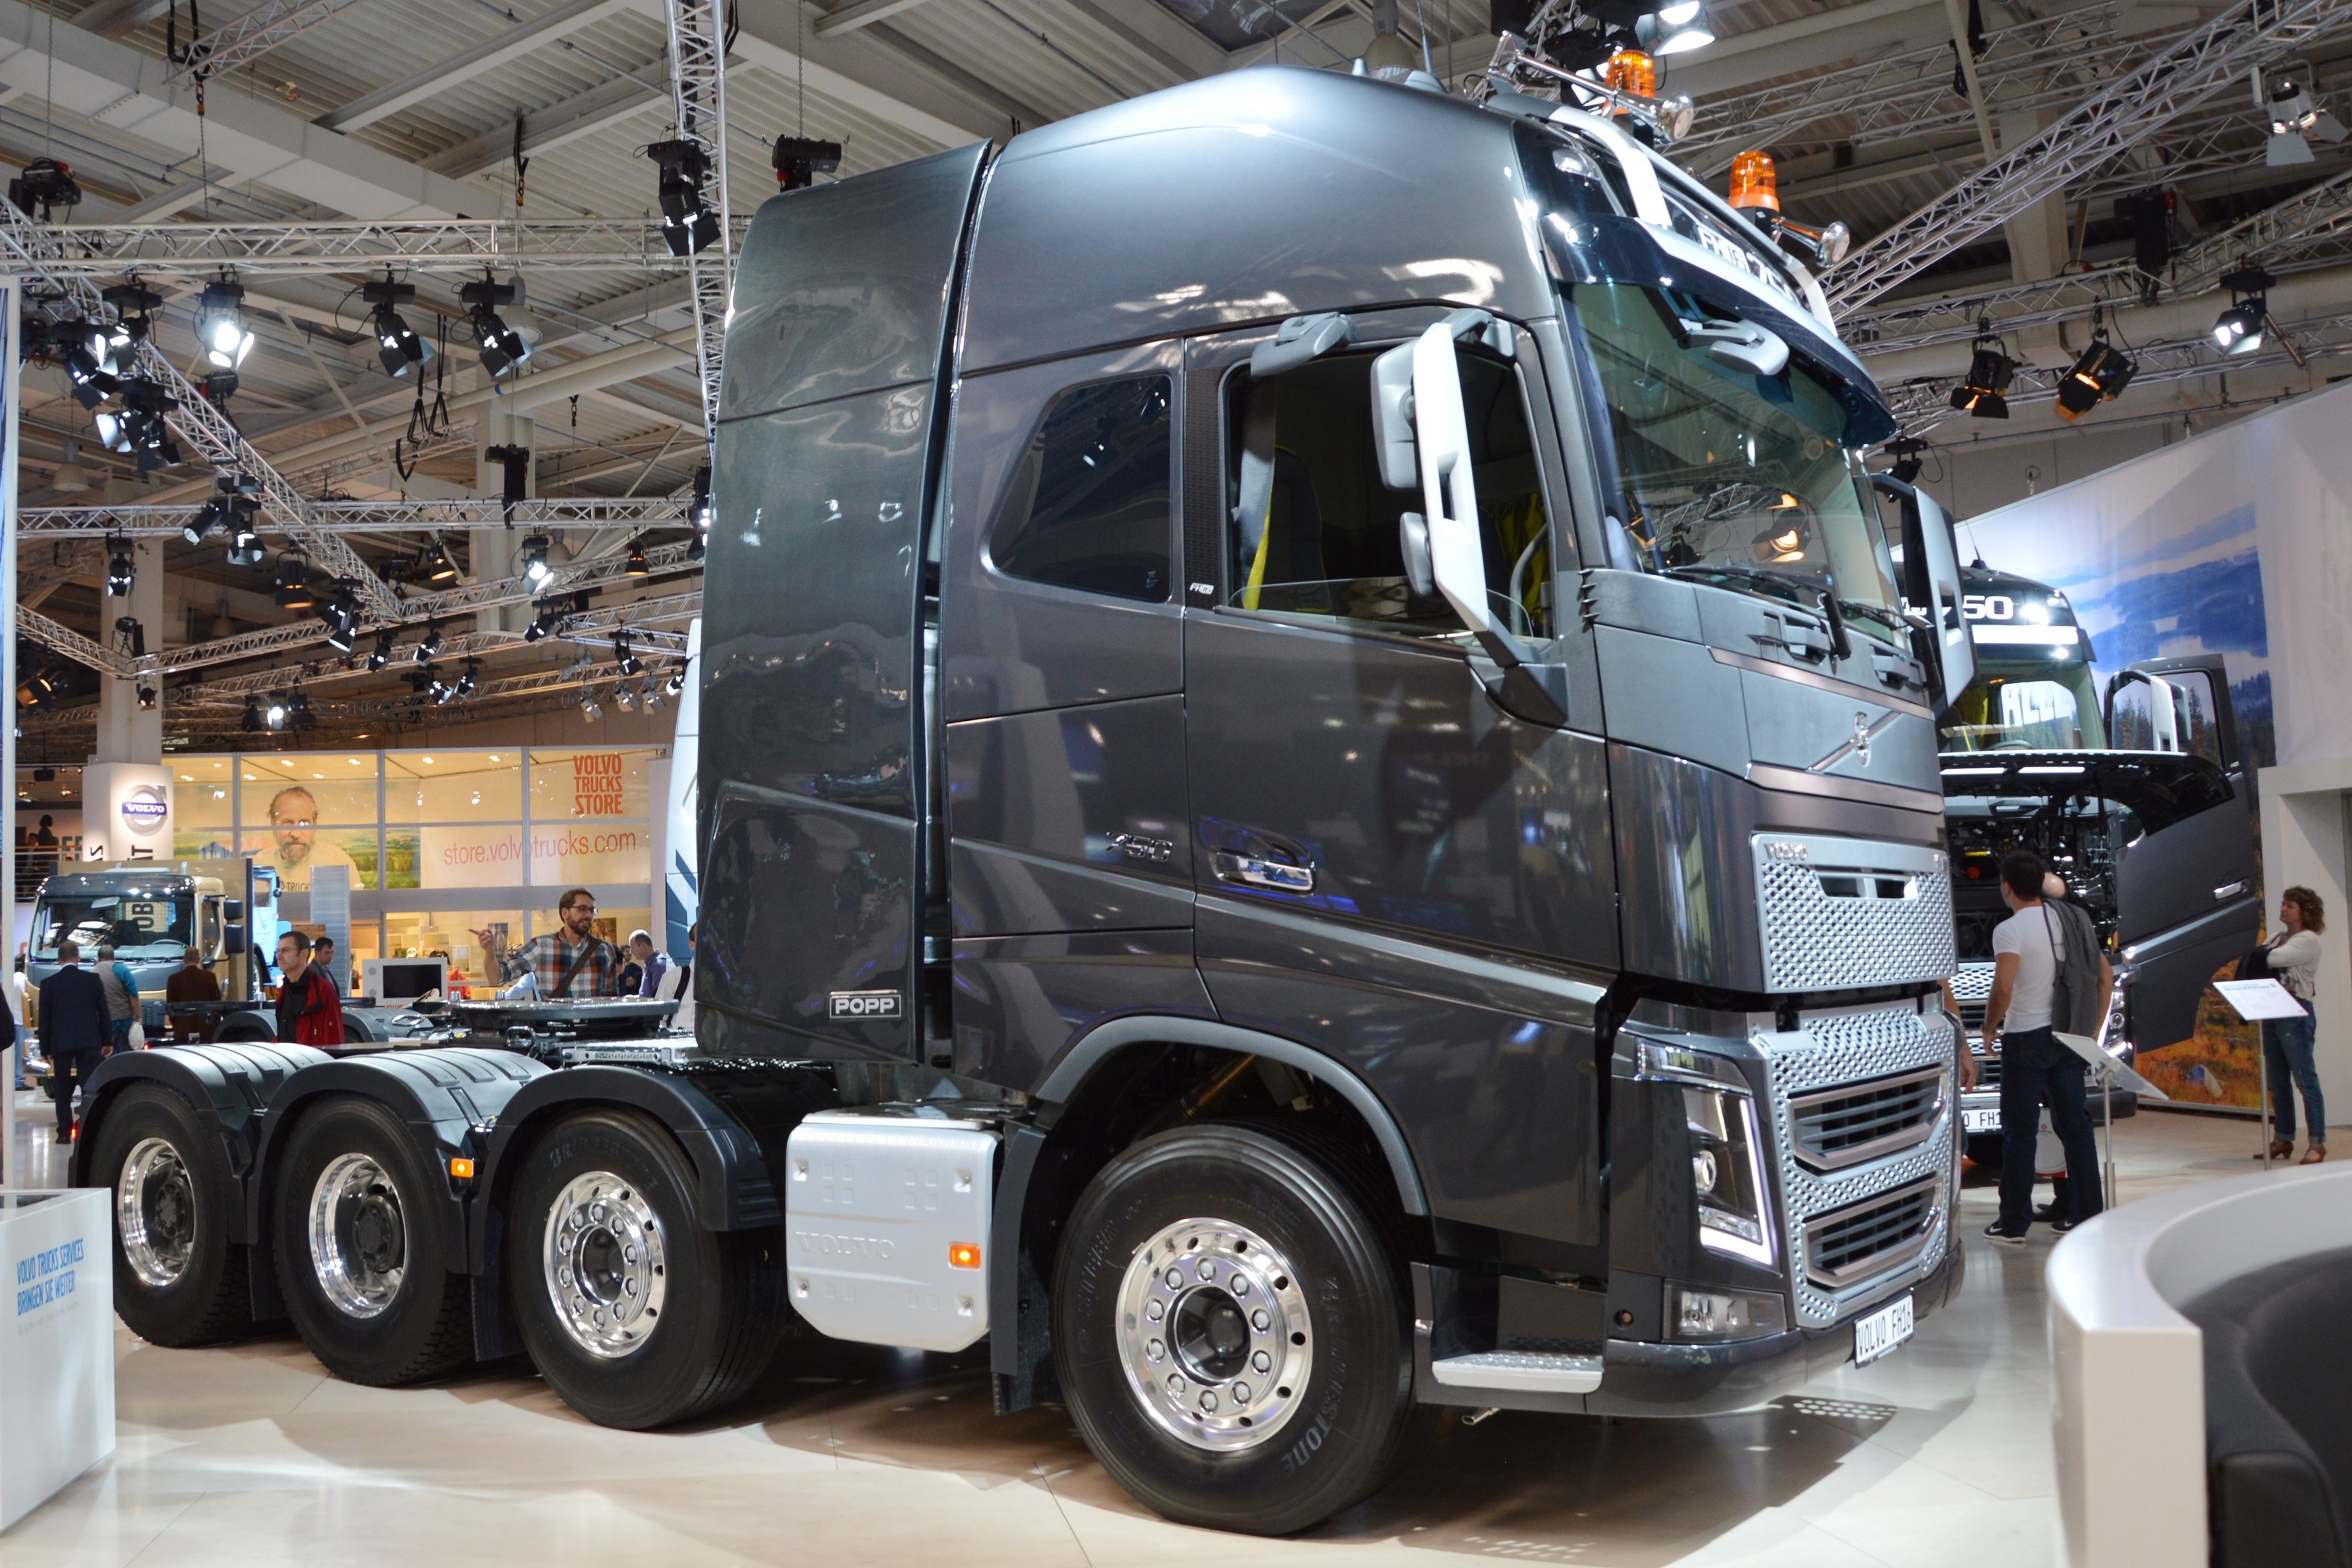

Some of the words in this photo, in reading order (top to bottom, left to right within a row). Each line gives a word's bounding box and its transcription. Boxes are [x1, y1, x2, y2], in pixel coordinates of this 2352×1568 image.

[573, 754, 622, 775] VOLVO
[574, 776, 622, 793] TRUCKS
[126, 804, 166, 813] VOLVO
[575, 793, 623, 814] STORE
[1106, 832, 1173, 862] 750
[1763, 842, 1807, 860] VOLVO
[835, 998, 895, 1014] POPP
[1979, 1112, 2002, 1127] FH1
[794, 1231, 895, 1259] VOLVO
[17, 1256, 36, 1285] VOLVO
[37, 1247, 59, 1277] TRUCKS
[60, 1237, 84, 1268] SERVICES
[17, 1283, 44, 1316] BRINGEN
[44, 1278, 54, 1304] SIE
[54, 1270, 76, 1299] WEITER
[1857, 1315, 1887, 1357] VOLVO
[1892, 1300, 1911, 1339] FH16
